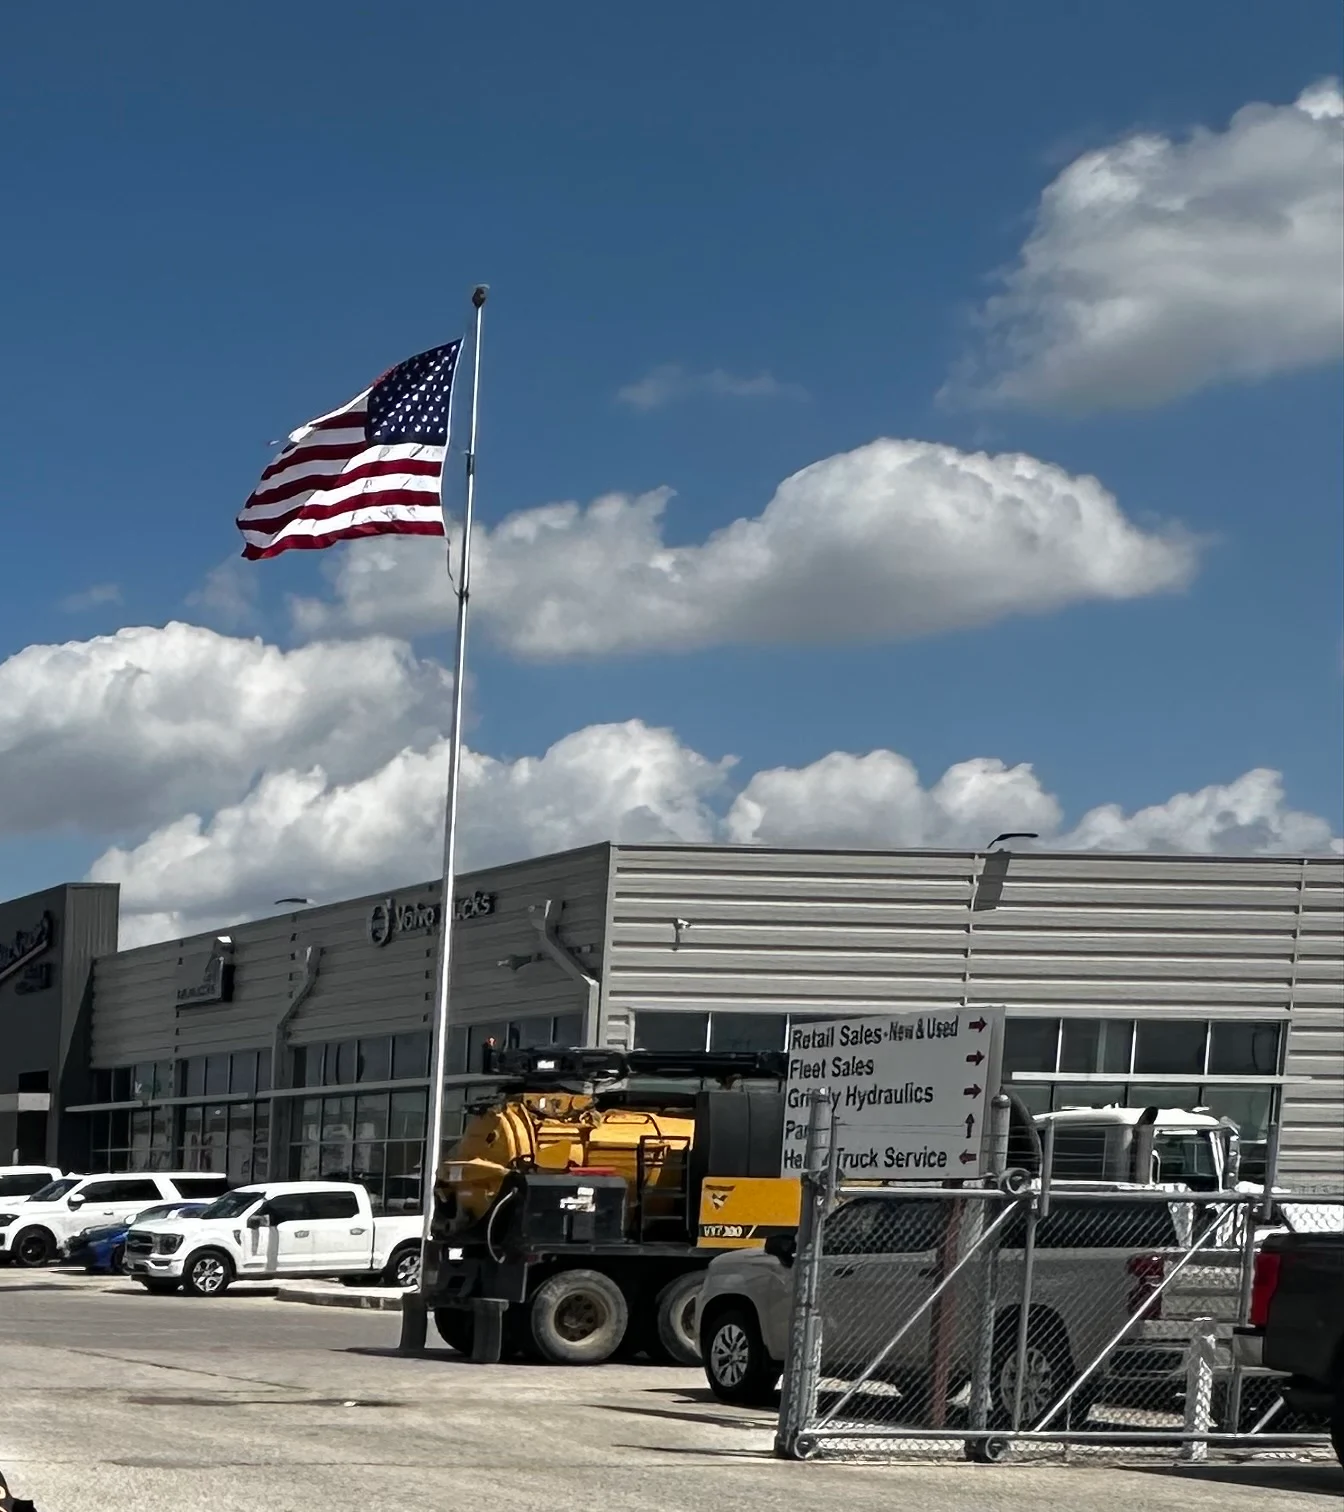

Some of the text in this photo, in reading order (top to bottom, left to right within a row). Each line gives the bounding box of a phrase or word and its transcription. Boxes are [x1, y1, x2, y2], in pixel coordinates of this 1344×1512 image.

[792, 1026, 835, 1050] Retail
[839, 1024, 882, 1047] Sales
[927, 1015, 960, 1039] Used
[790, 1055, 875, 1080] Fleet Sales
[787, 1082, 934, 1113] Grily Hydraulics
[837, 1147, 879, 1169] Truck
[884, 1145, 948, 1168] Service
